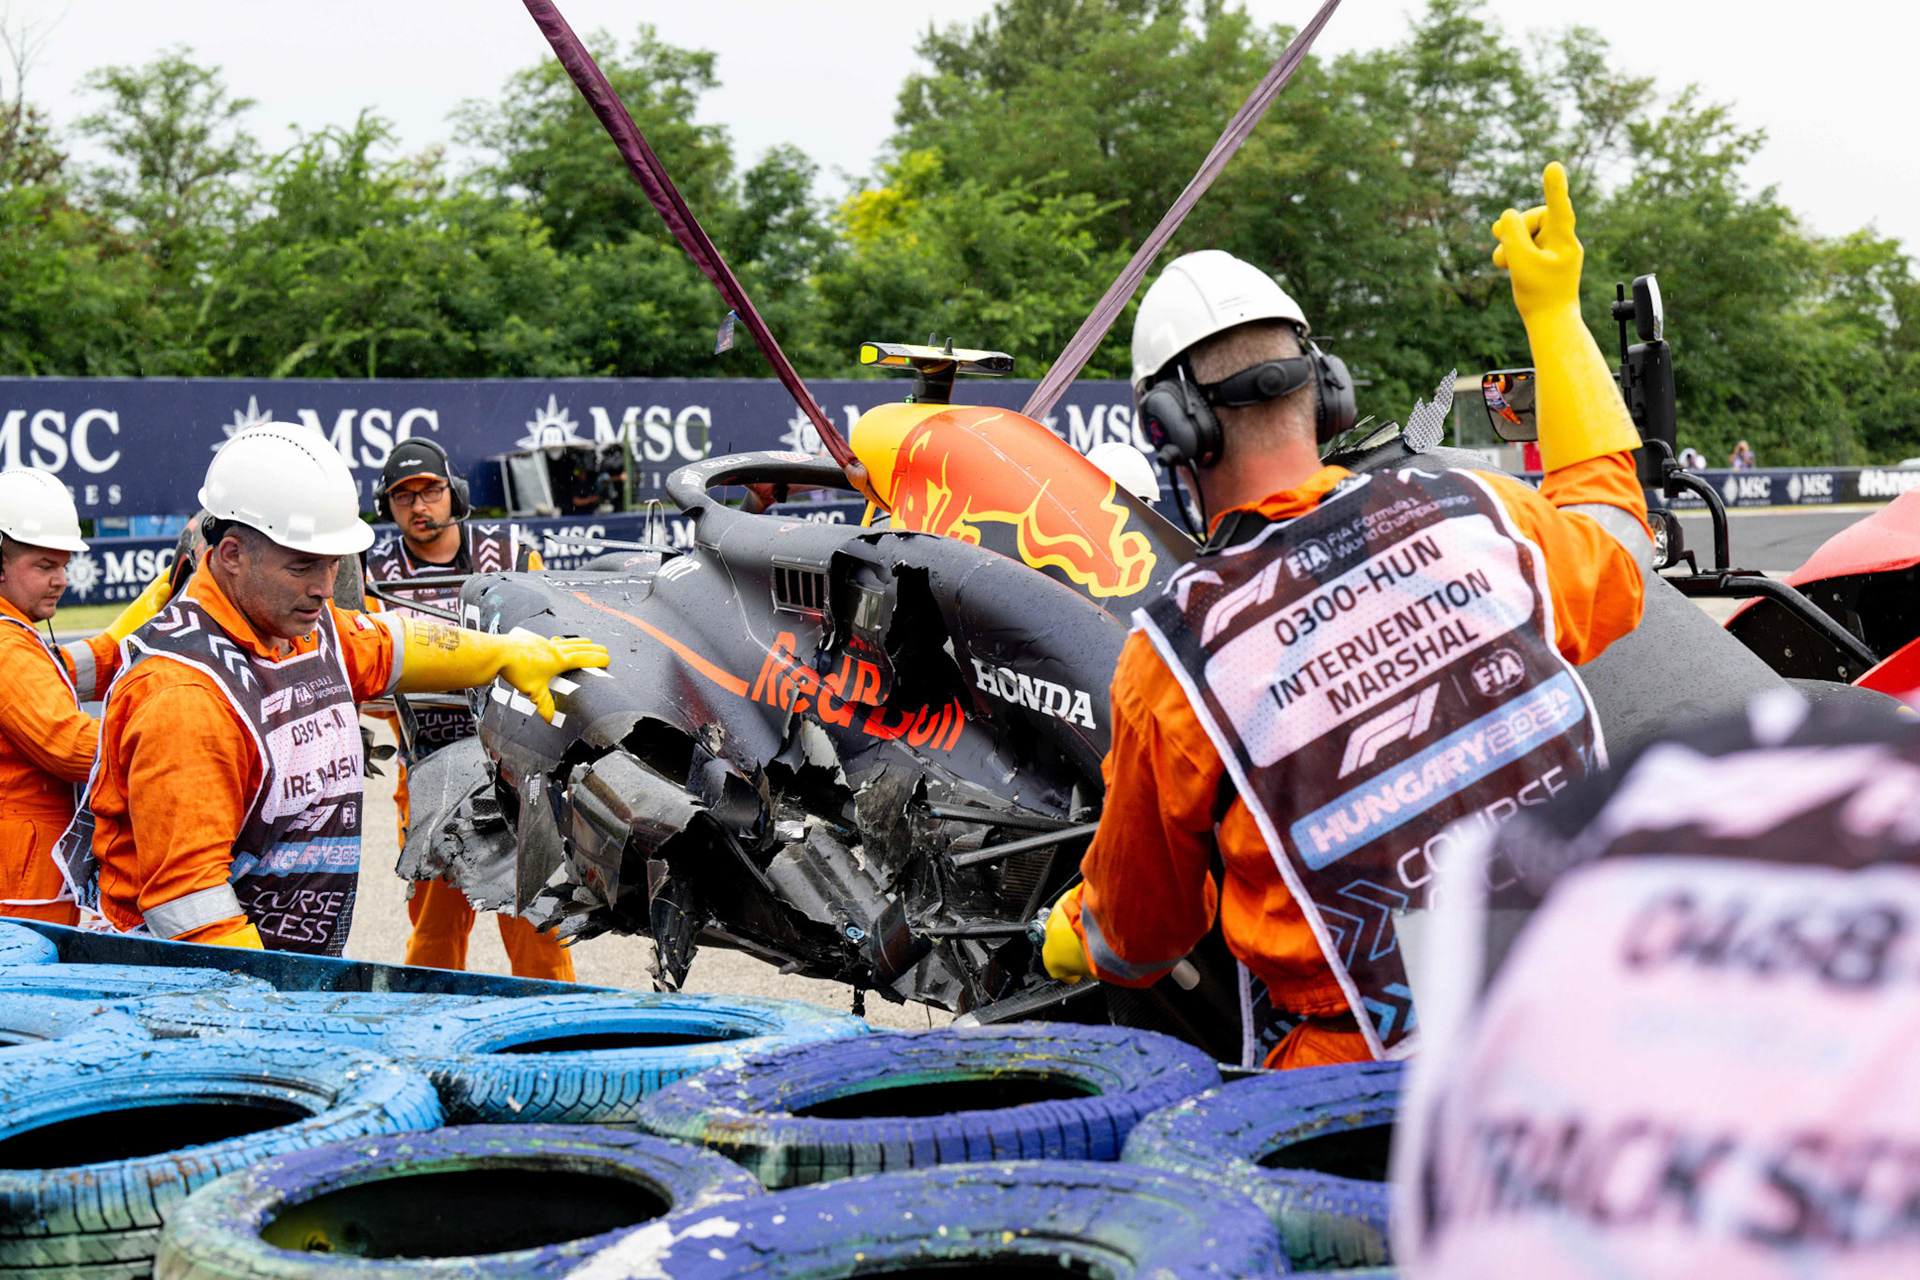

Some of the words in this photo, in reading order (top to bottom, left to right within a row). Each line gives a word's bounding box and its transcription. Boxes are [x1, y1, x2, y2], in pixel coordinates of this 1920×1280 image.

[589, 405, 713, 463] MSC
[1739, 476, 1772, 499] MSC
[1801, 474, 1833, 496] MSC
[543, 524, 606, 558] MSC
[1274, 535, 1443, 647] 0300-HUN
[1269, 568, 1493, 710] INTERVENTION
[1326, 618, 1480, 716] MARSHAL
[751, 631, 860, 728] Red
[971, 657, 1097, 730] HONDA
